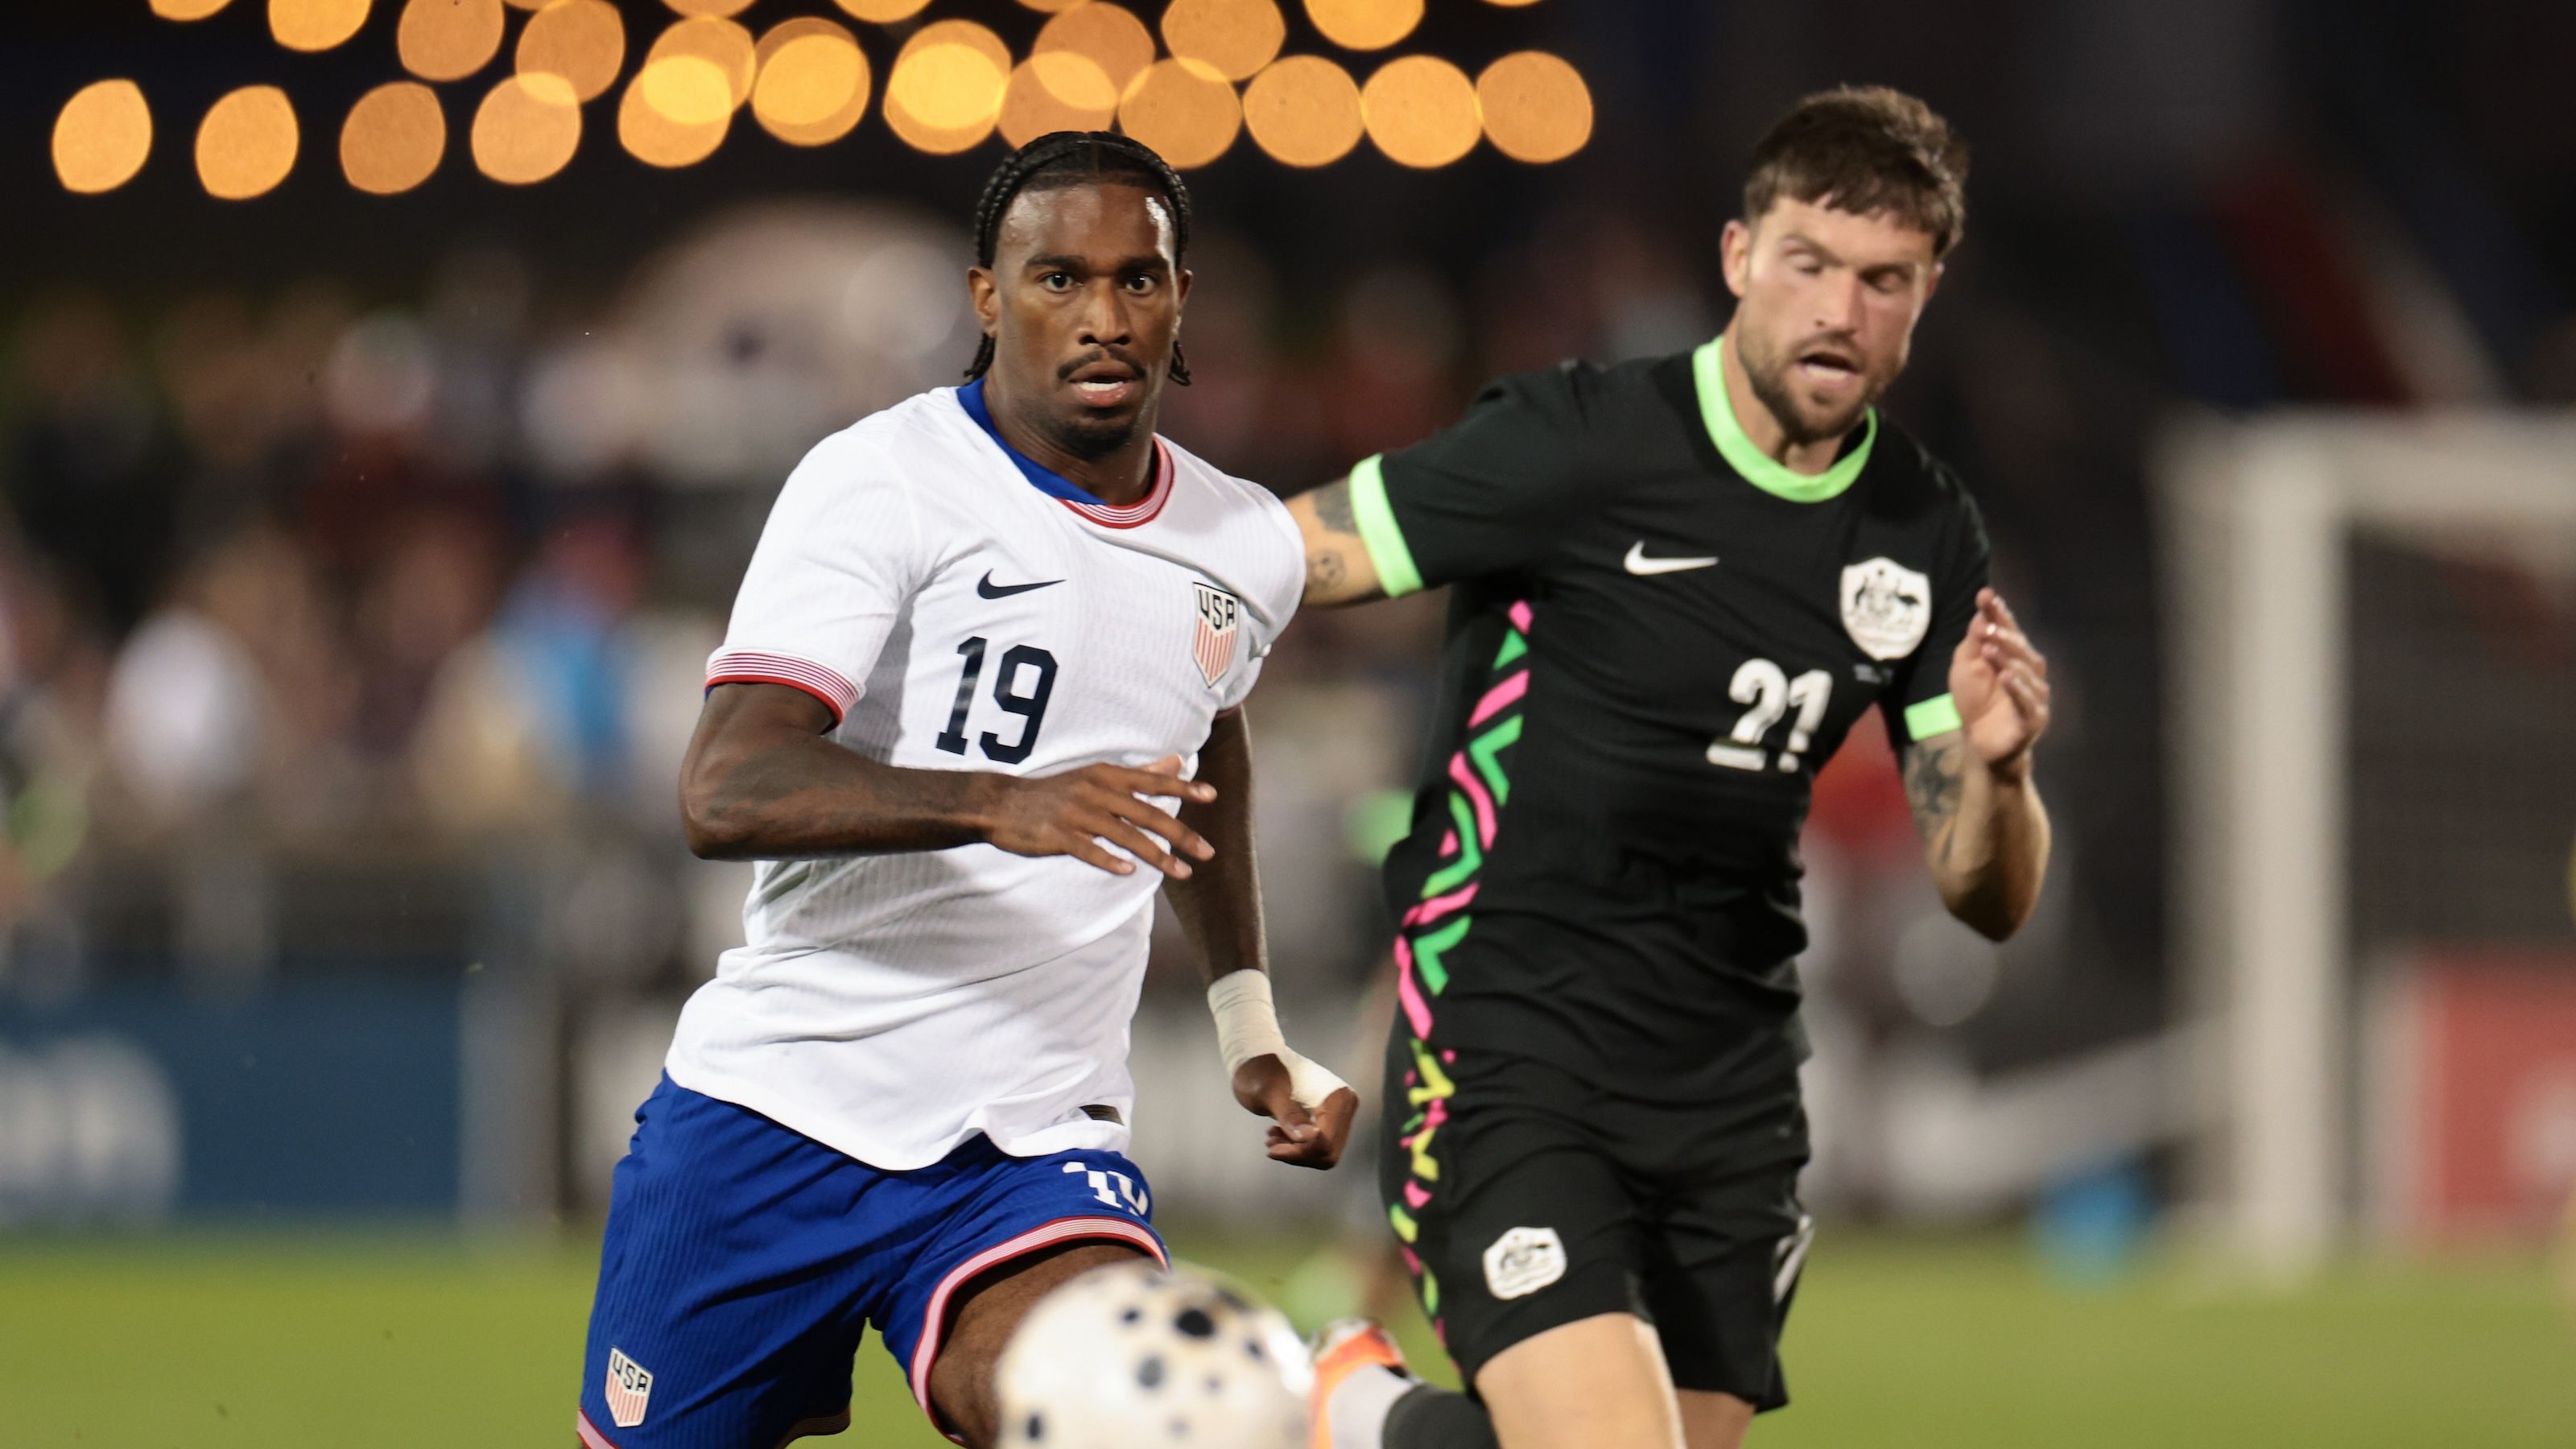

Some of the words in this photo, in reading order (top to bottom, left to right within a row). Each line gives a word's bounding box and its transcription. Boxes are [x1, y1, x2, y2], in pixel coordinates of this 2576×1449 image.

[1198, 588, 1236, 630] USA
[935, 636, 1058, 765] 19
[1705, 658, 1833, 773] 21
[613, 1353, 648, 1393] USA
